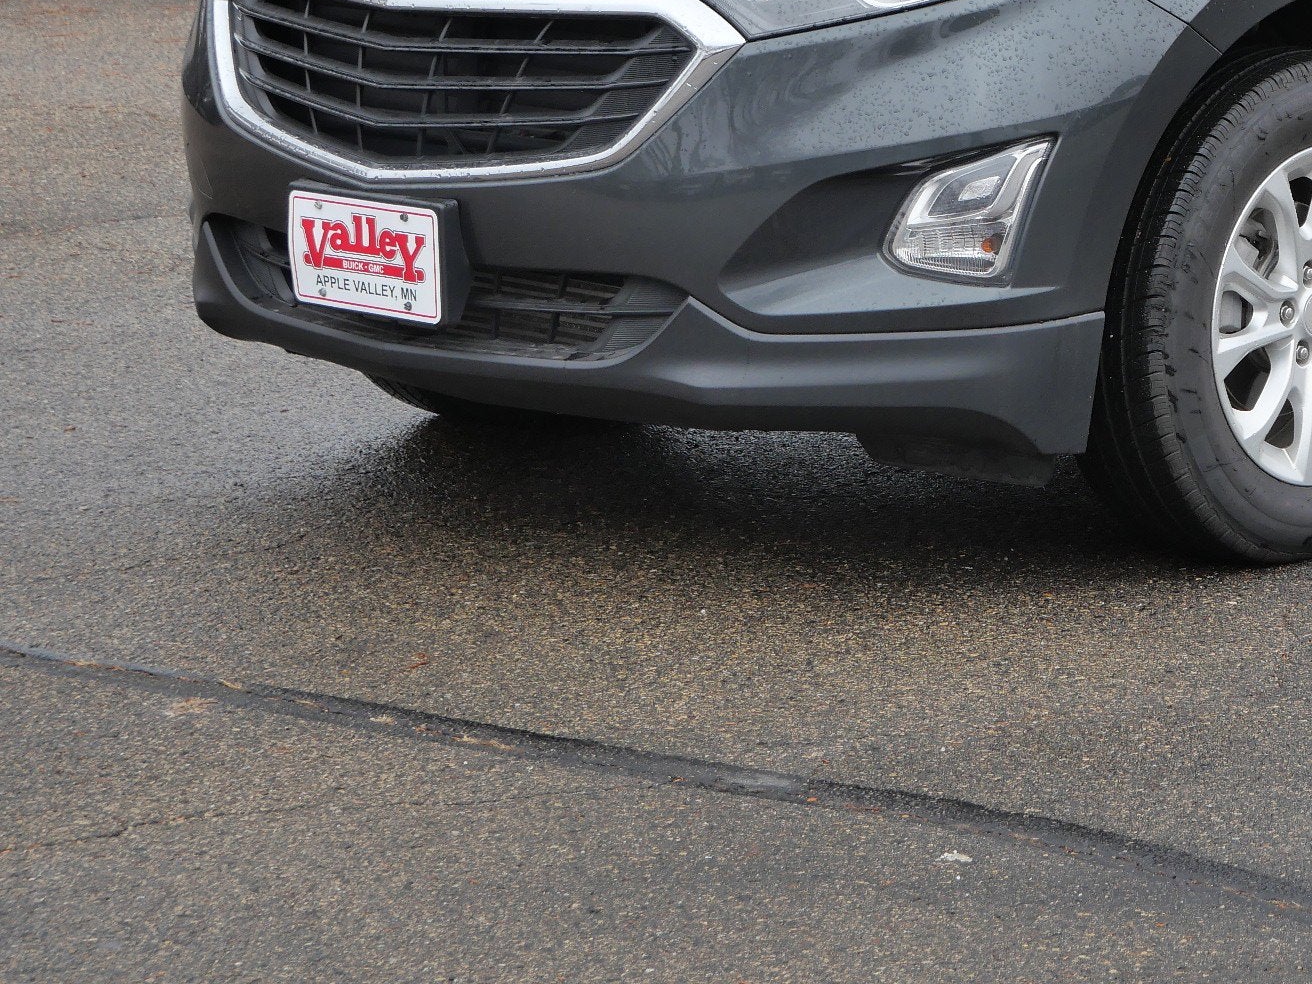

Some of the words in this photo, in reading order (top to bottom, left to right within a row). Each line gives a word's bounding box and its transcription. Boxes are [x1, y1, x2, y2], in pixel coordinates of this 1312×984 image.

[342, 259, 364, 271] BUICK
[368, 262, 385, 274] GMC
[316, 274, 351, 291] APPLE
[353, 280, 398, 300] VALLEY,
[401, 287, 417, 302] MN
